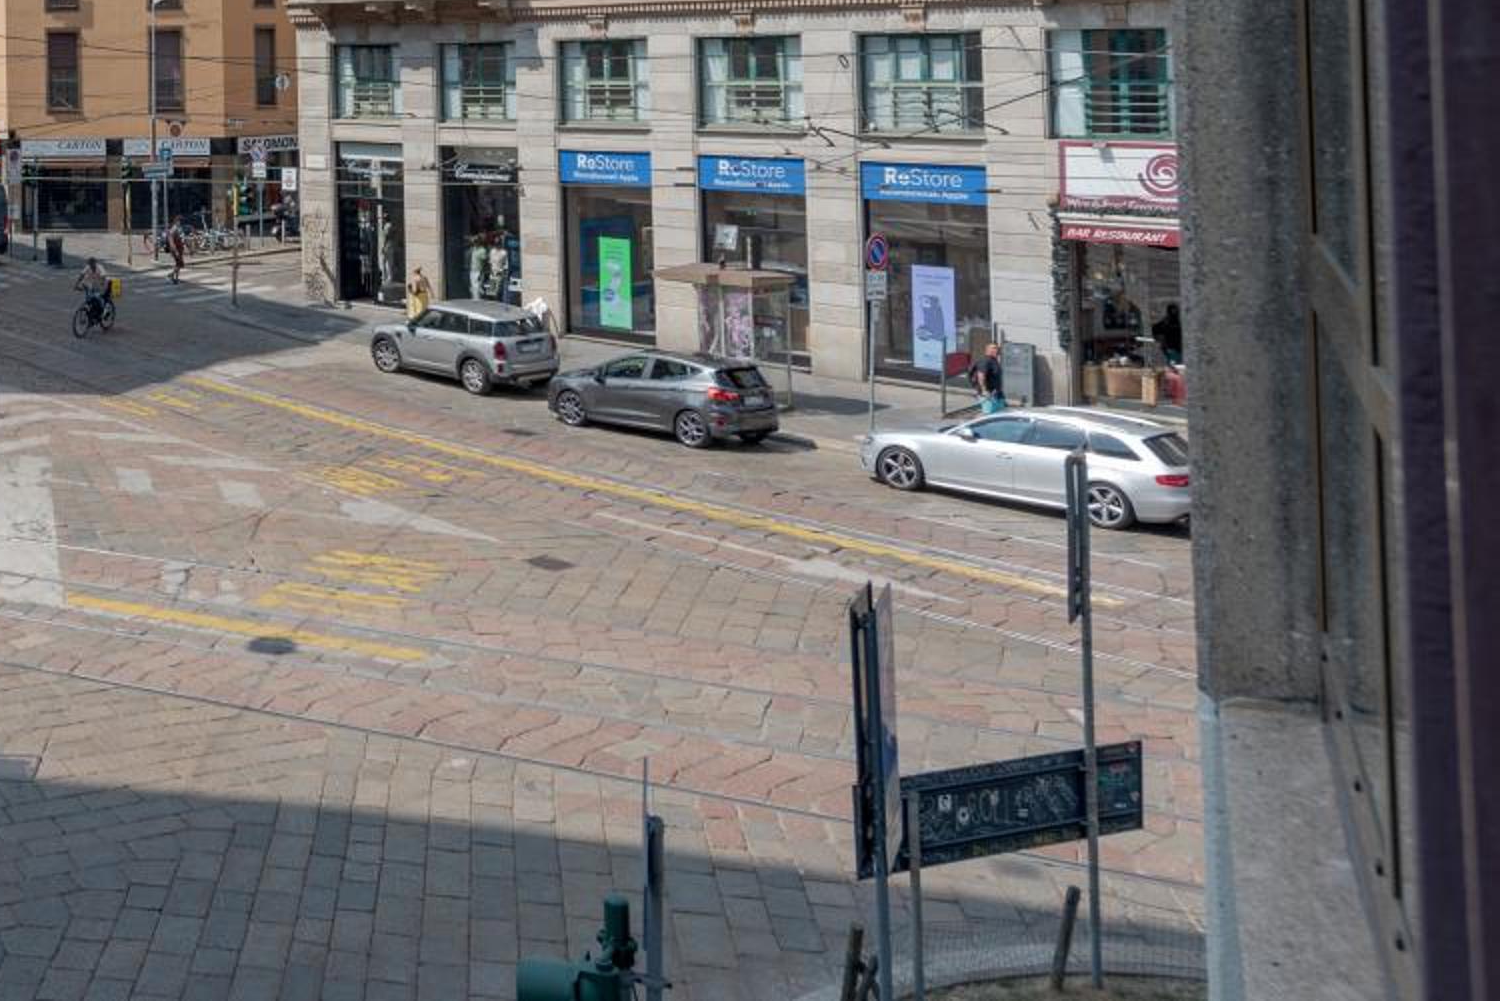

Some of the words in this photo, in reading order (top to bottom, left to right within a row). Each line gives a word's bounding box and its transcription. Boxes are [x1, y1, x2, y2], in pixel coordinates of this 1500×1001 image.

[577, 153, 636, 171] ReStore
[718, 159, 787, 178] ReStore
[884, 166, 963, 188] ReStore
